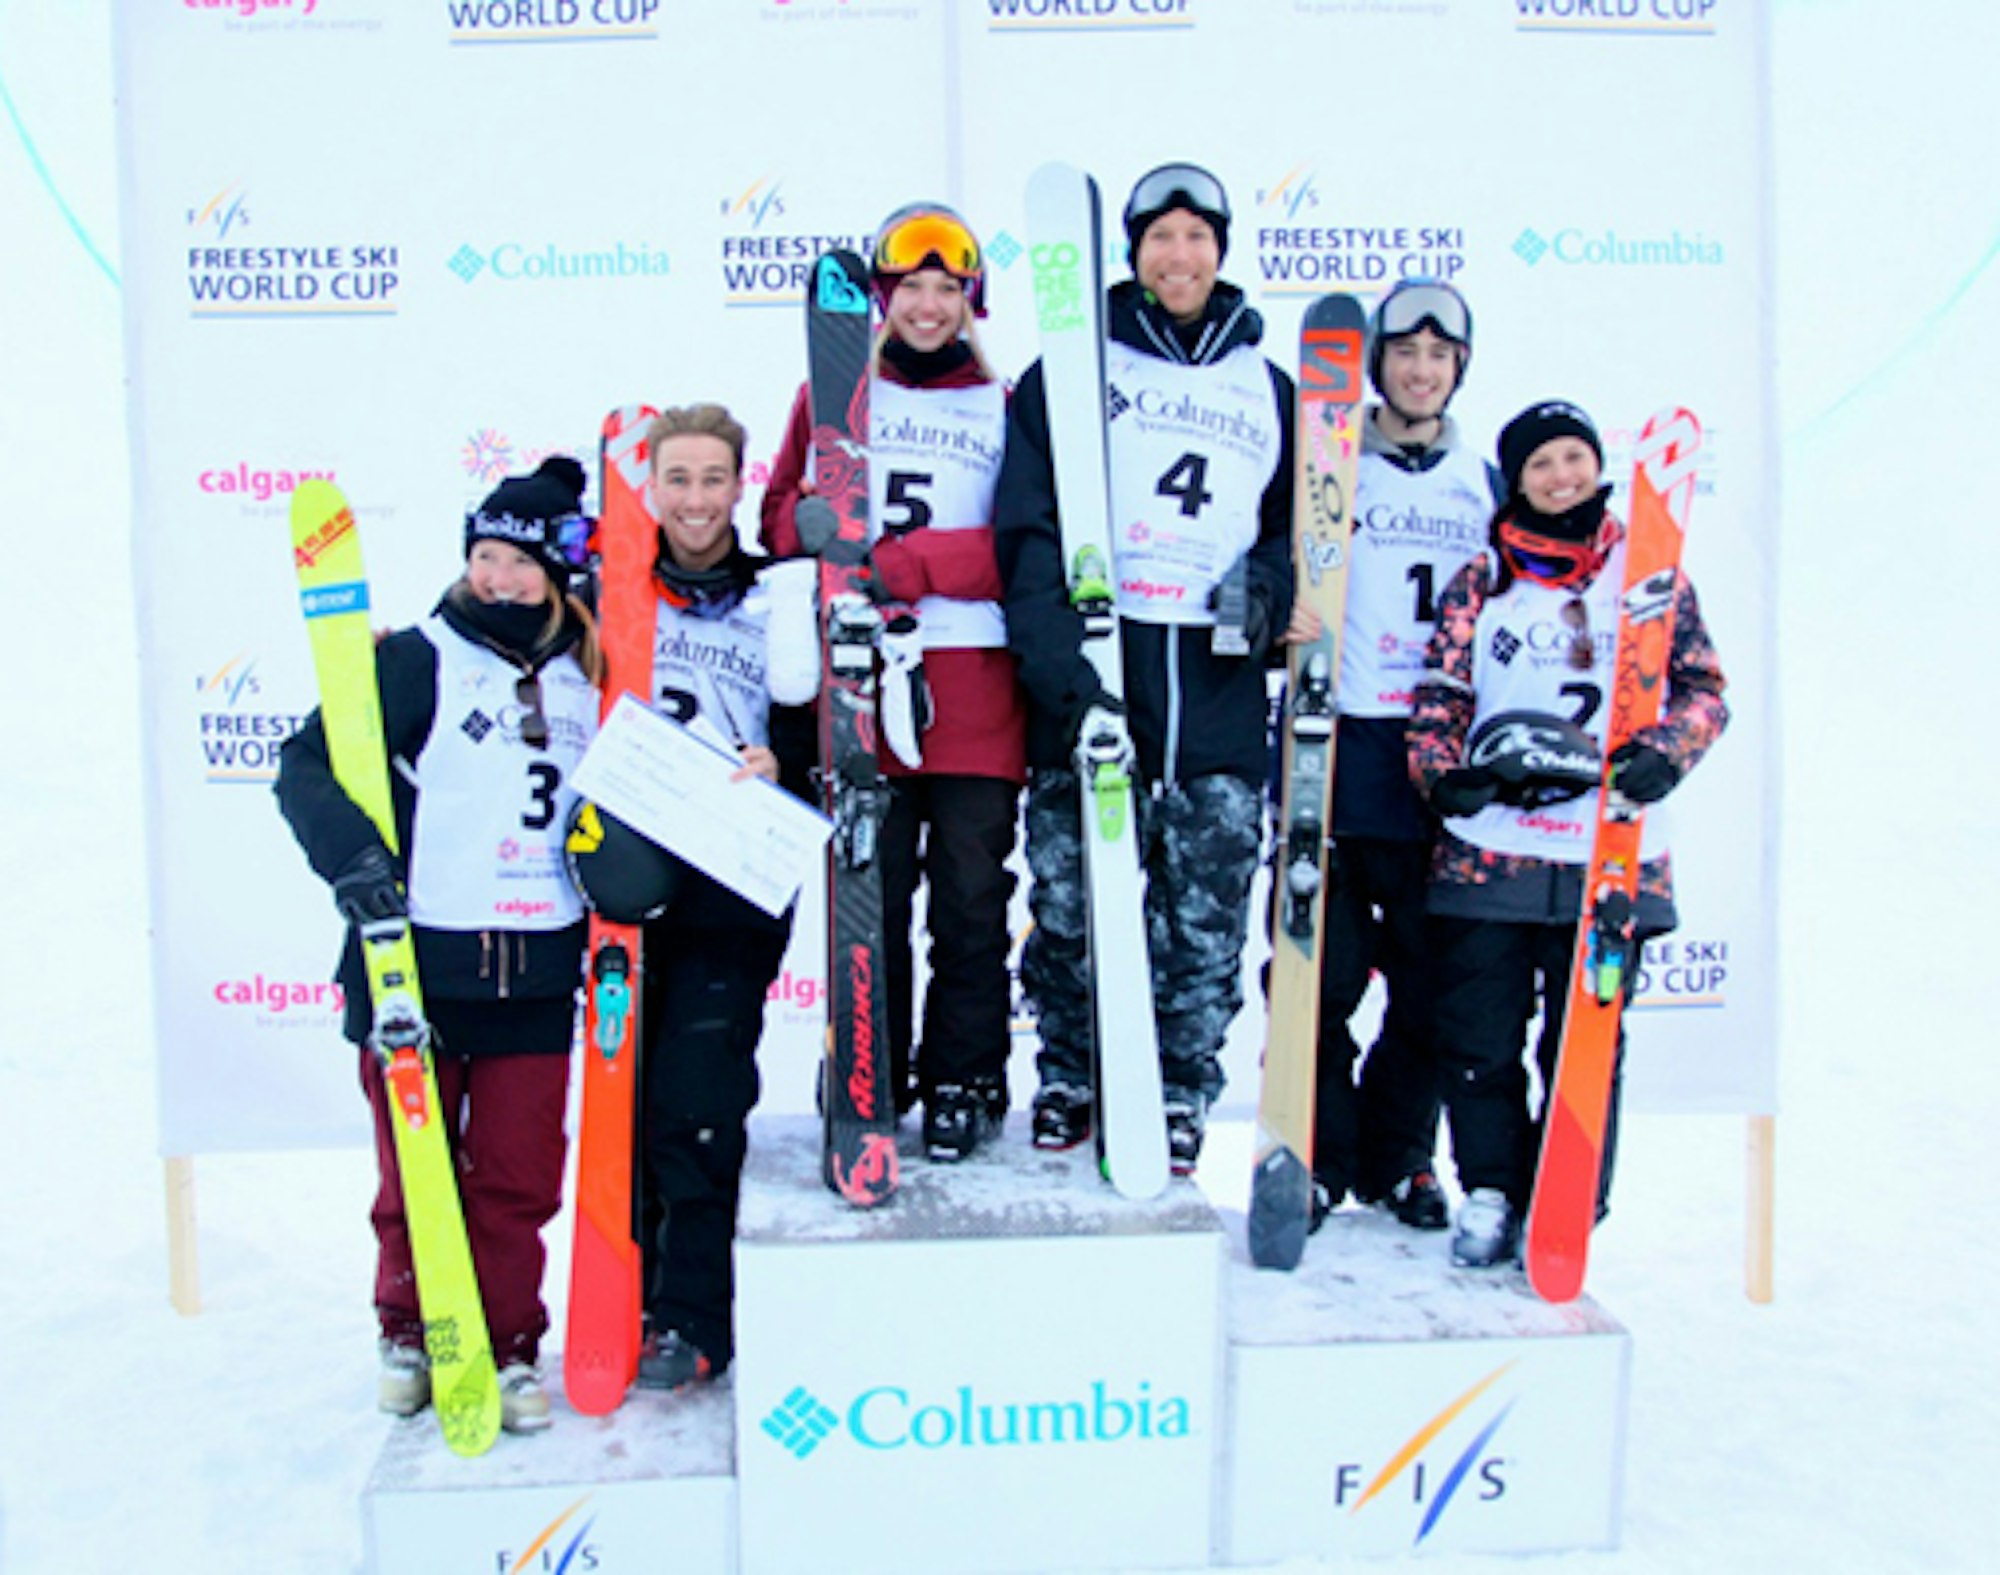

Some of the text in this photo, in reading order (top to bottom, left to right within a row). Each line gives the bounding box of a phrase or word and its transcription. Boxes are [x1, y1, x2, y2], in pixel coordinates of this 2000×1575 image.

[448, 0, 659, 28] WORLD CUP
[188, 246, 398, 268] FREESTYLE SKI
[1258, 228, 1463, 249] FREESTYLE SKI
[1553, 228, 1724, 266] Columbia
[491, 241, 670, 280] Columbia
[723, 264, 808, 290] WOR
[1259, 254, 1464, 281] WORLD CUP
[189, 272, 398, 300] WORLD CUP
[1135, 387, 1268, 449] Columbia
[878, 416, 1002, 465] olumbia
[198, 460, 336, 501] calgar
[1154, 451, 1213, 519] 4
[882, 468, 933, 535] 5
[1365, 503, 1480, 542] Columbi
[1121, 578, 1186, 602] calgary
[1406, 562, 1435, 622] 1
[656, 627, 765, 686] olumbia
[1559, 681, 1603, 729] 2
[201, 714, 301, 736] FREEST
[203, 740, 282, 768] WOR
[521, 760, 562, 830] 3
[1516, 811, 1584, 837] calgary
[1684, 941, 1728, 963] SKI
[213, 972, 347, 1013] calgary
[1663, 964, 1726, 994] CUP
[847, 1379, 1191, 1450] Columbia
